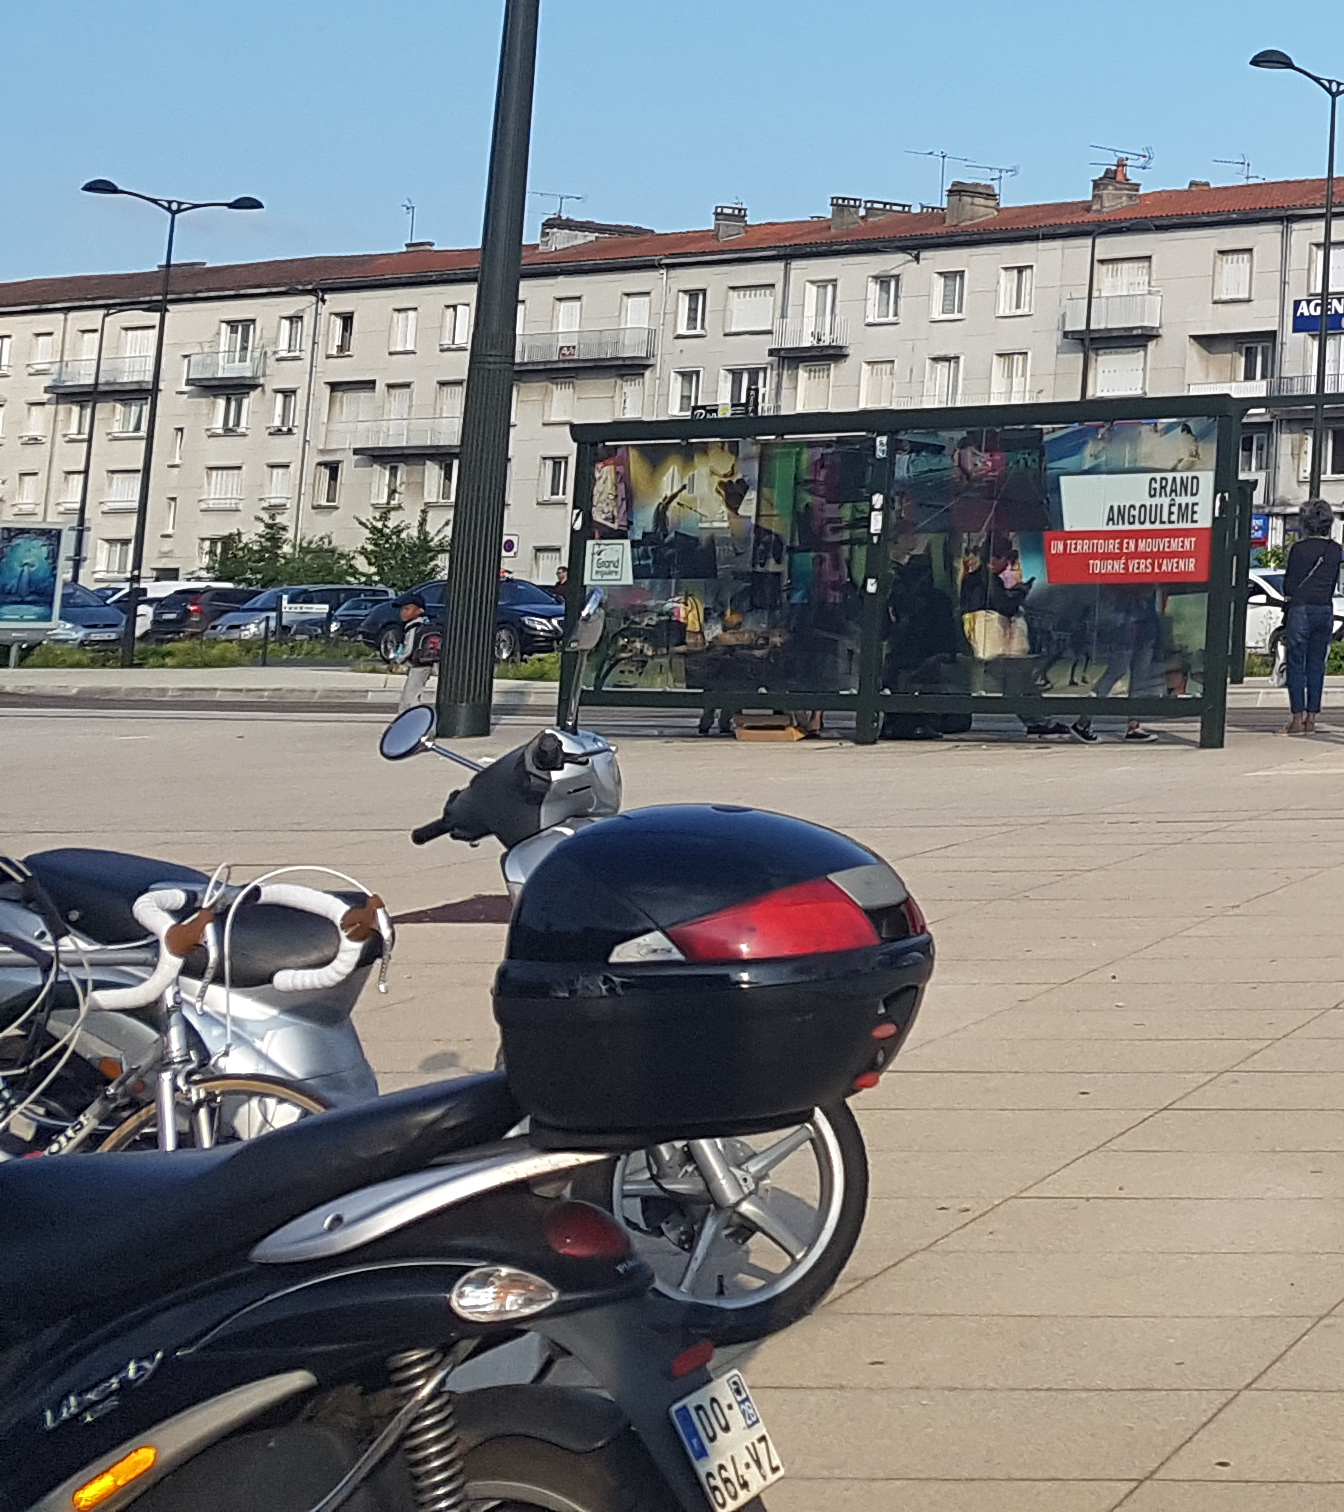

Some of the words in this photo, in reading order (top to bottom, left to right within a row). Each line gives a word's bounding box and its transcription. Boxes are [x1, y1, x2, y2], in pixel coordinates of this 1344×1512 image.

[1149, 476, 1200, 498] GRAND
[1106, 498, 1199, 526] ANGOULÊME
[1051, 541, 1063, 554] UN
[1067, 540, 1120, 553] TERRITOIRE
[1123, 539, 1135, 552] EN
[1138, 537, 1196, 552] MOUVEMENT
[1089, 556, 1125, 573] TOURNÉ
[1129, 559, 1151, 573] VERS
[1154, 558, 1195, 572] L'AVENIR
